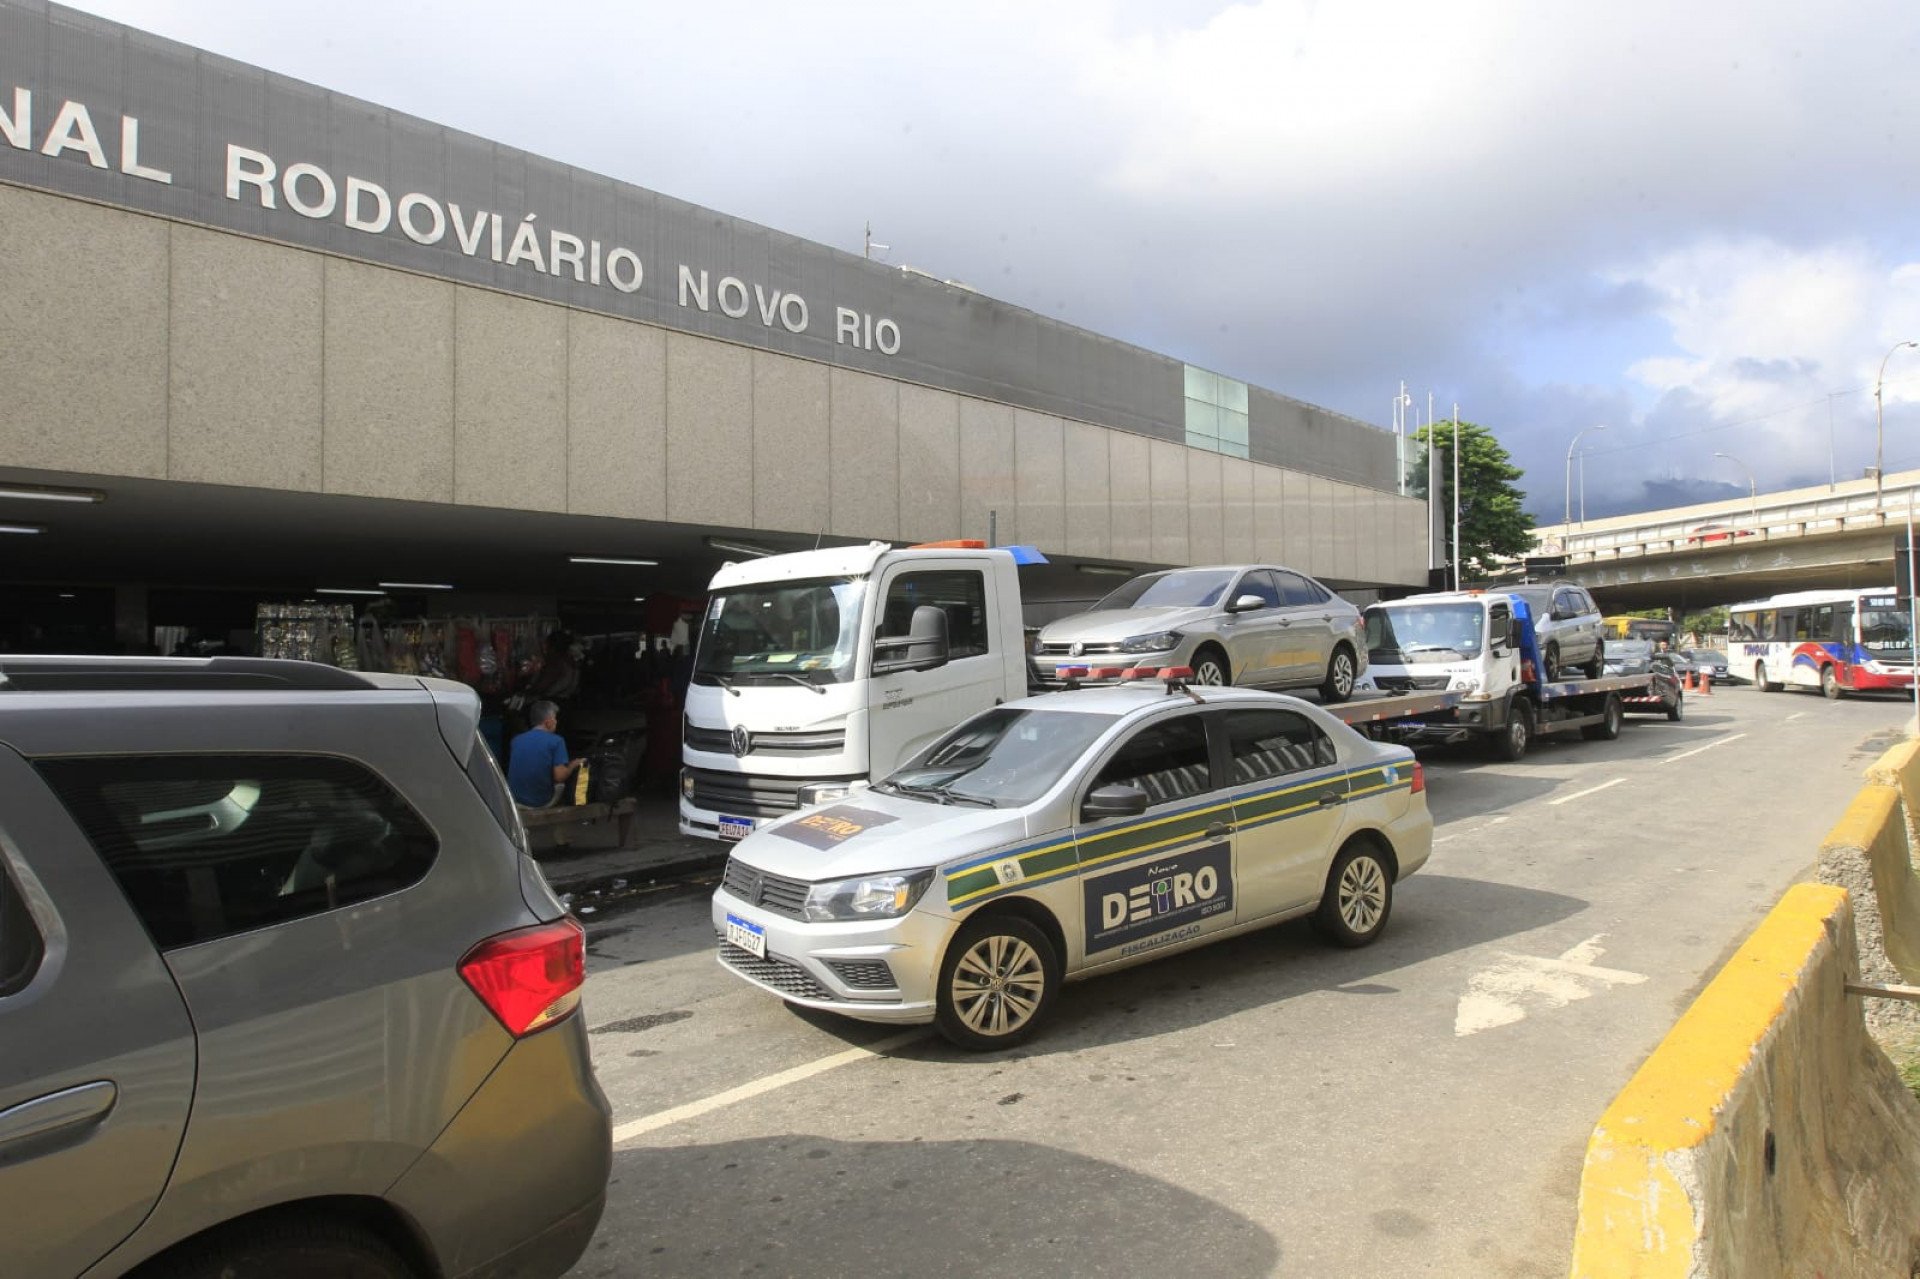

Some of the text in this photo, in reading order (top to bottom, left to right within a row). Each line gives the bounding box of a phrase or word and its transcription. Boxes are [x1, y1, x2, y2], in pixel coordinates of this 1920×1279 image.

[226, 143, 643, 293] RODOVIÁRIO
[678, 264, 809, 333] NOVO
[836, 306, 901, 355] RIO
[1147, 864, 1178, 877] Novo
[1103, 865, 1218, 931] DETRO
[1121, 924, 1201, 956] FISCALIZAÇÃO
